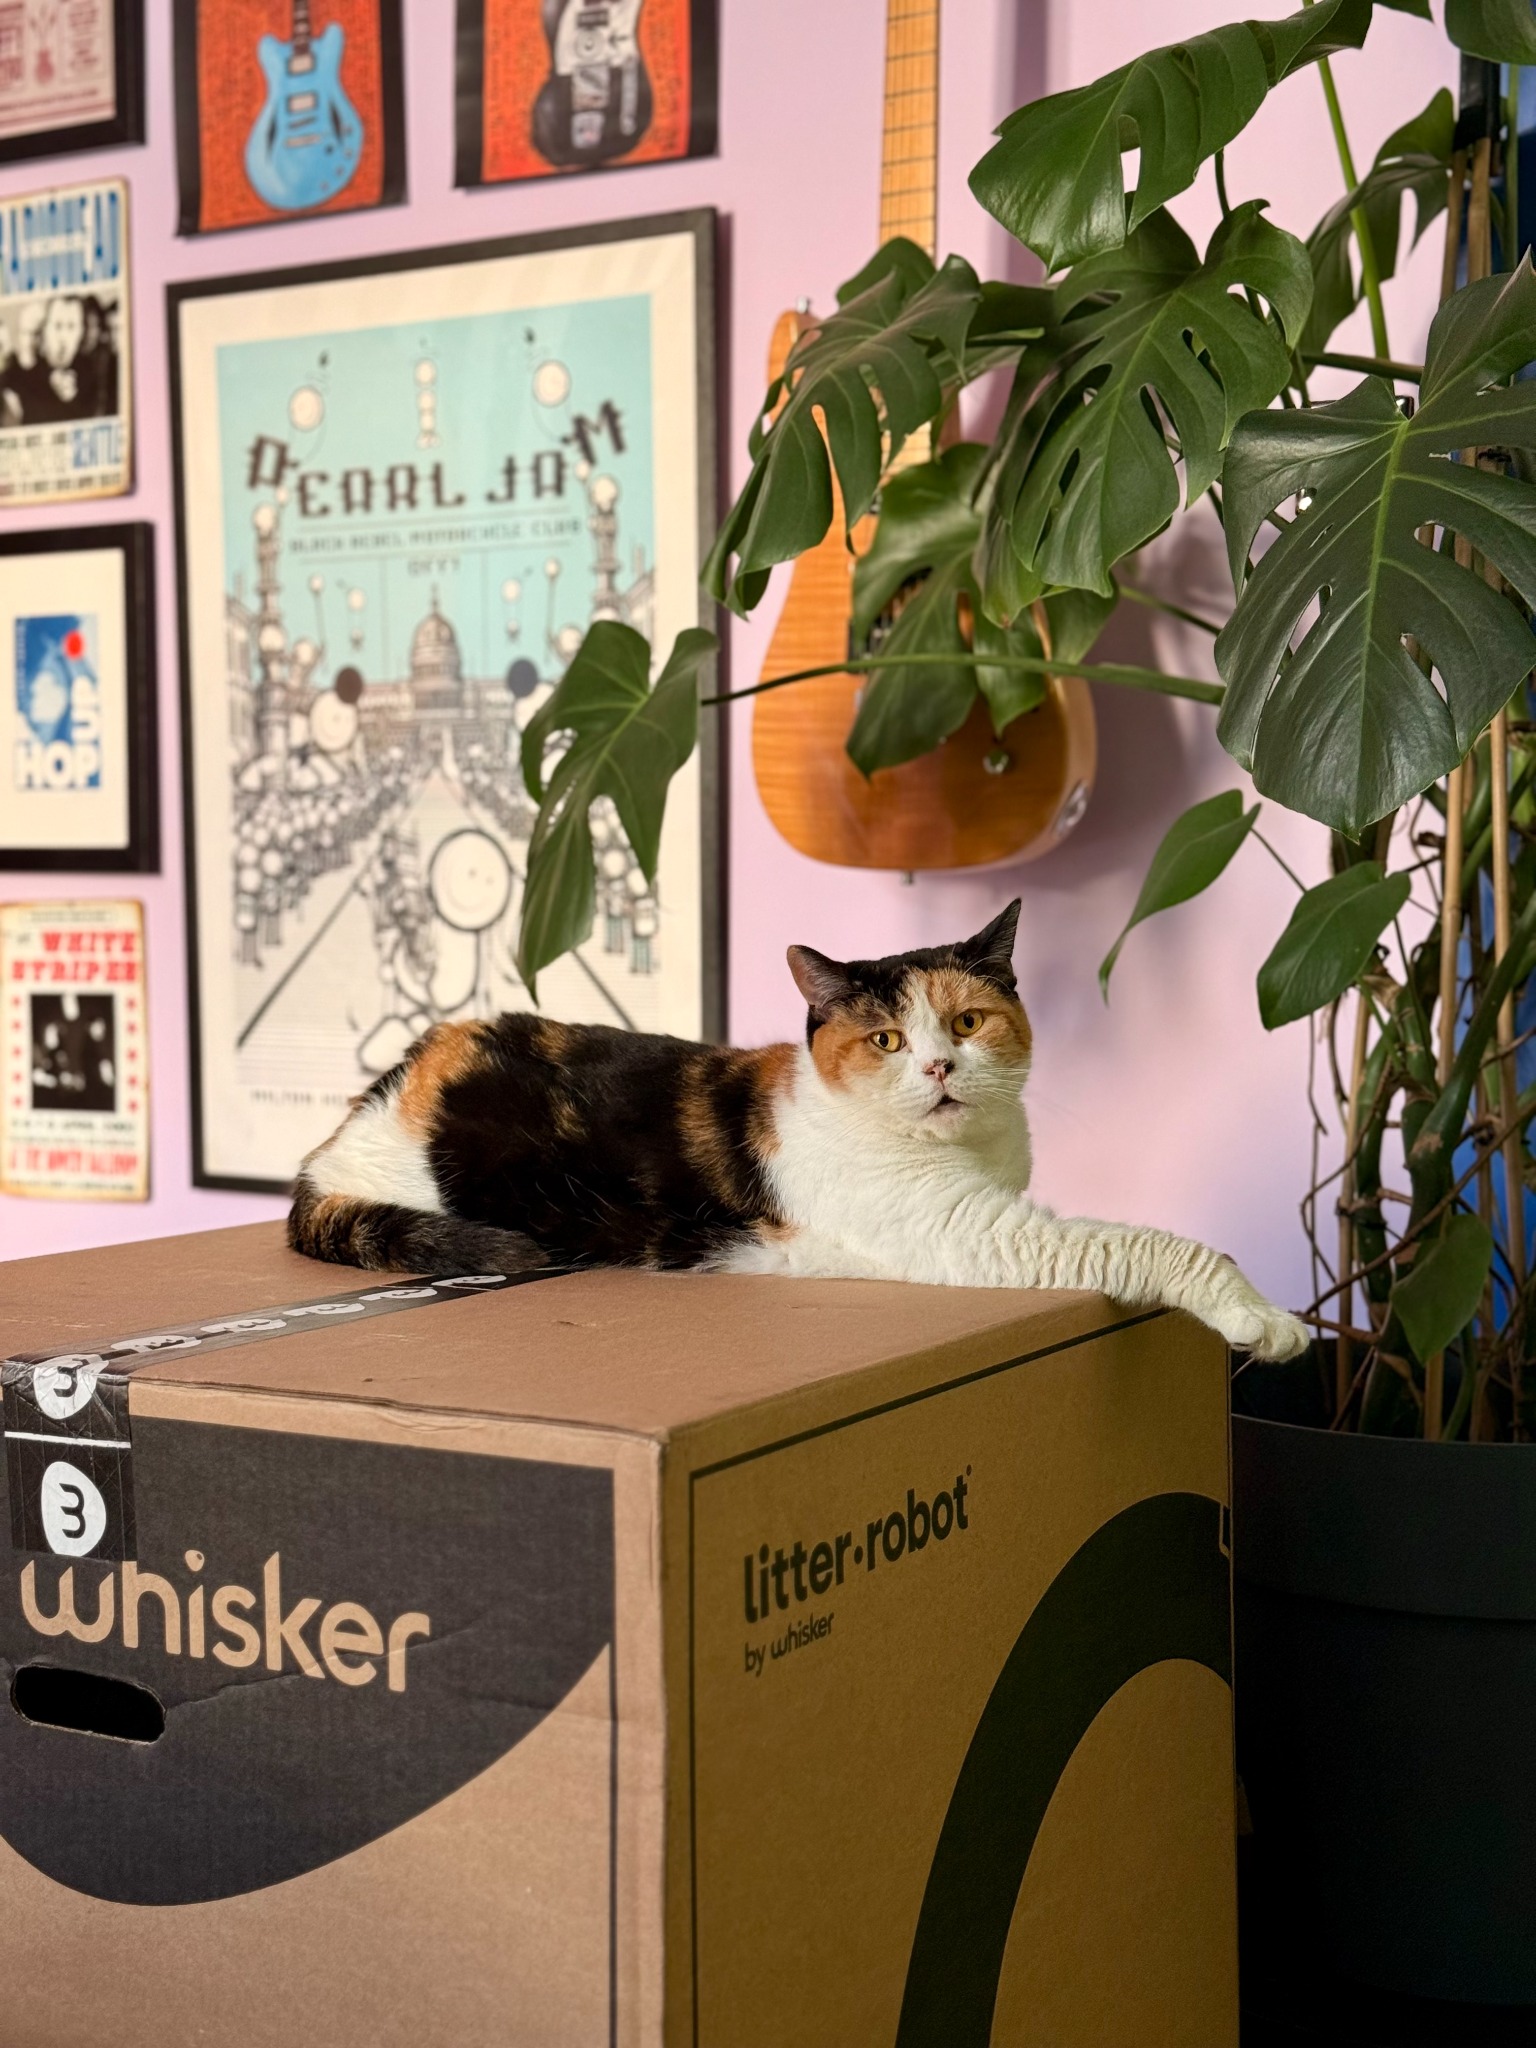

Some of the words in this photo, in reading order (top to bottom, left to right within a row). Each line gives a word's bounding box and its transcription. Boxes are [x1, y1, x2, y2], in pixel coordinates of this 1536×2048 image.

[246, 434, 466, 519] PEARL
[485, 399, 629, 504] JAM
[12, 960, 137, 981] STRIPES
[43, 931, 136, 952] WHITE
[19, 1549, 431, 1693] whisker
[744, 1642, 767, 1678] by
[770, 1611, 835, 1661] whisker
